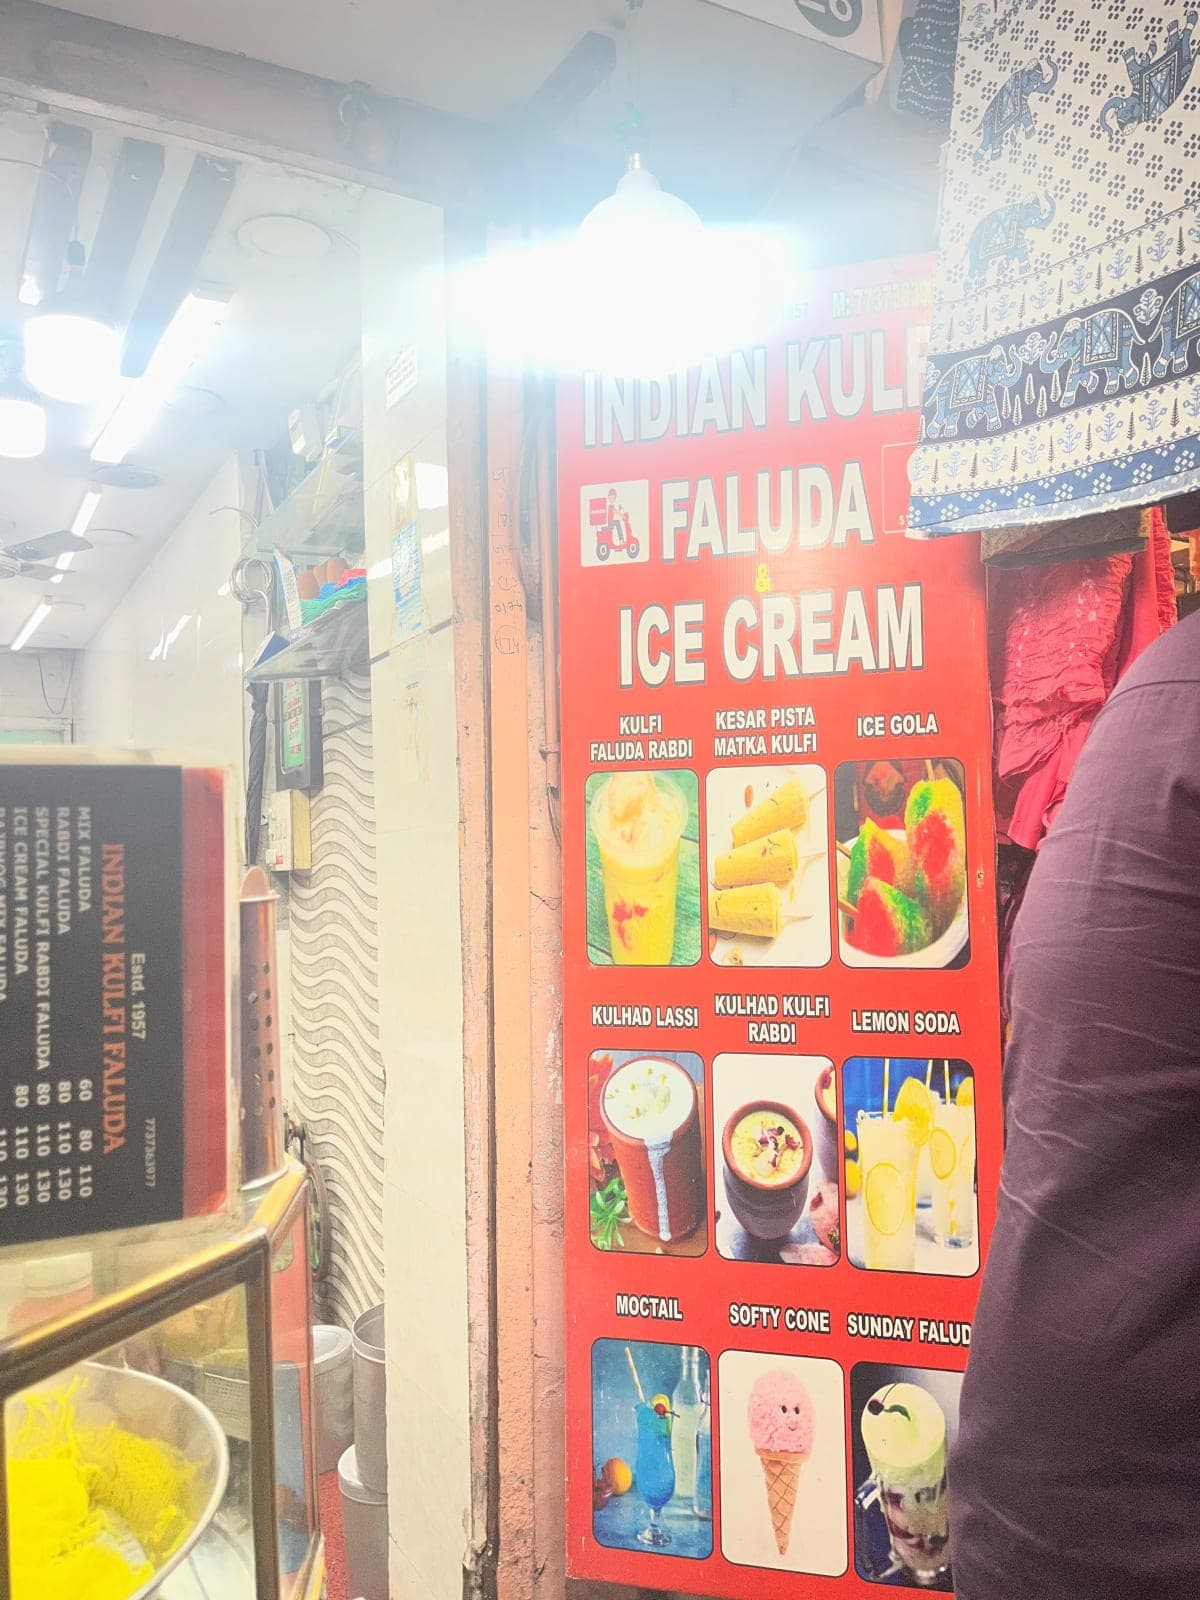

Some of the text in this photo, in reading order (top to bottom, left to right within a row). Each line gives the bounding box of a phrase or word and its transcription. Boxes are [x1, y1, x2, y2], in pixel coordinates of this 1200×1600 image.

[583, 343, 768, 448] INDIAN
[661, 460, 875, 563] FALUDA
[755, 562, 771, 593] &
[619, 581, 924, 689] ICE CREAM
[619, 714, 662, 735] KULFI
[713, 732, 817, 757] MATKA KULFI
[715, 706, 815, 731] KESAR PISTA
[856, 713, 938, 737] ICE GOLA
[590, 739, 693, 762] FALUDA RABDI
[57, 807, 71, 935] RABDI FALUDA
[78, 807, 92, 912] MIX FALUDA
[14, 807, 29, 975] ICE CREAM FALUDA
[36, 807, 50, 1070] SPECIAL KULFI RABDI FALUDA
[102, 843, 127, 1155] INDIAN KULFI FALUDA
[130, 953, 147, 1040] Estd. 1957
[591, 1005, 699, 1028] KULHAD LASSI
[714, 994, 830, 1018] KULHAD KULFI
[851, 1010, 960, 1034] LEMON SODA
[748, 1022, 796, 1044] RABDI
[15, 1085, 29, 1206] 80 110 130
[36, 1083, 50, 1203] 80 110 130
[58, 1081, 72, 1200] 80 110 130
[79, 1079, 93, 1198] 60 80 110
[615, 1294, 683, 1321] MOCTAIL
[729, 1304, 830, 1334] SOFTY CONE
[847, 1315, 971, 1346] SUNDAY FALUD
